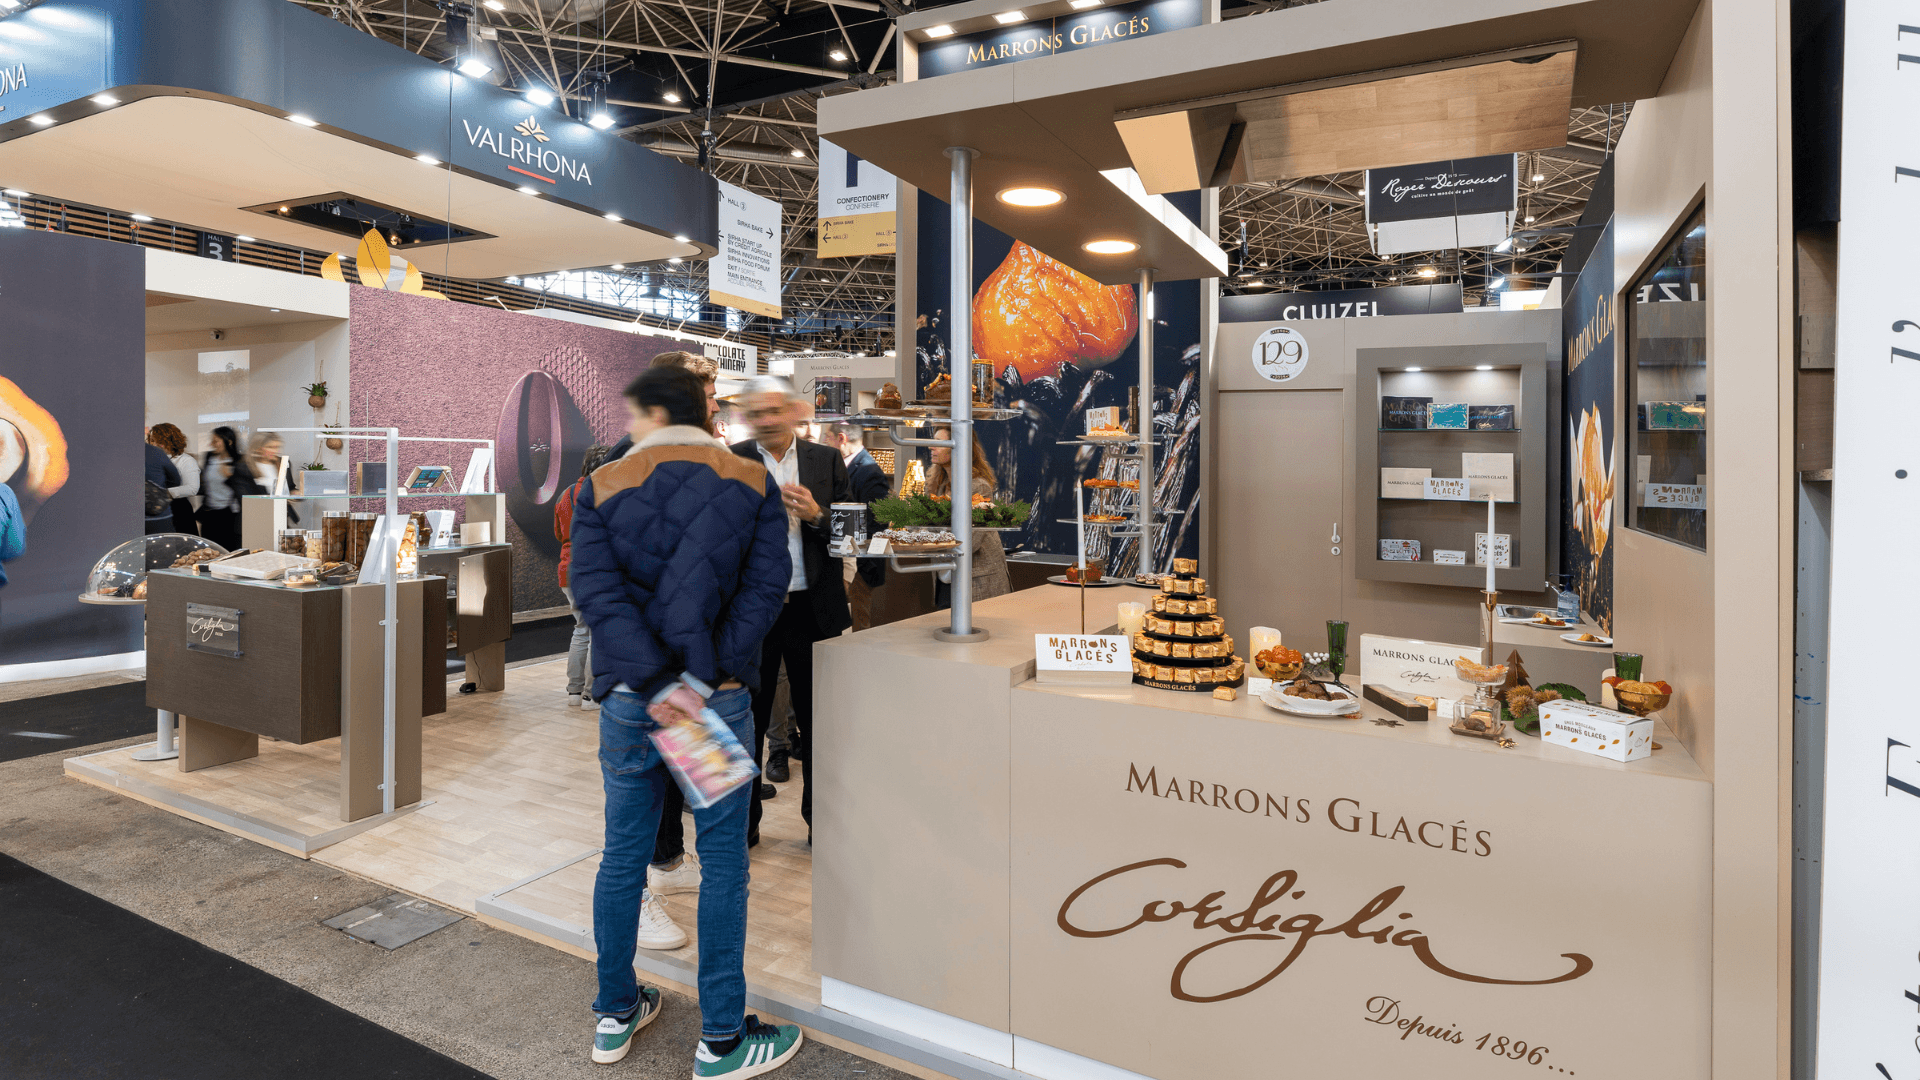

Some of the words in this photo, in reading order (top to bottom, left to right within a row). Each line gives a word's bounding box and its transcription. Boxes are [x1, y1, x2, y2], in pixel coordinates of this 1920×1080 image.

[966, 33, 1063, 65] MARRONS
[1069, 15, 1150, 45] GLACÉS
[462, 118, 592, 186] VALRHONA
[1381, 178, 1426, 203] Roger
[728, 198, 739, 208] HALL
[836, 193, 890, 205] CONFECTIONERY
[846, 201, 880, 211] CONFISERIE
[737, 219, 750, 228] SIRHA
[752, 224, 763, 233] BAKE
[207, 234, 224, 243] HALL
[728, 233, 741, 242] SIRHA
[742, 238, 755, 247] START
[209, 242, 223, 261] 3
[728, 247, 741, 256] SIRHA
[742, 251, 770, 265] INNOVATIONS
[751, 247, 772, 259] AGRICOLE
[728, 254, 741, 264] SIRHA
[742, 259, 754, 268] FOOD
[755, 263, 770, 272] FORUM
[728, 263, 737, 272] EXIT
[727, 271, 740, 280] MAIN
[740, 275, 763, 287] ENTRANCE
[1282, 301, 1385, 321] CLUIZEL
[1260, 340, 1302, 365] 129
[1430, 479, 1464, 490] MARRONS
[1049, 637, 1117, 653] MARRONS
[1055, 649, 1113, 664] GLACÉS
[1372, 648, 1425, 663] MARRONS
[1144, 680, 1171, 690] MARRONS
[1171, 683, 1196, 691] GLACÉS
[1555, 723, 1582, 736] MARRONS
[1125, 762, 1310, 824] MARRONS
[1327, 797, 1492, 857] GLACÉS
[1056, 857, 1594, 1003] Corsiglia
[1364, 995, 1465, 1045] Depuis
[1475, 1034, 1576, 1077] 1896...
